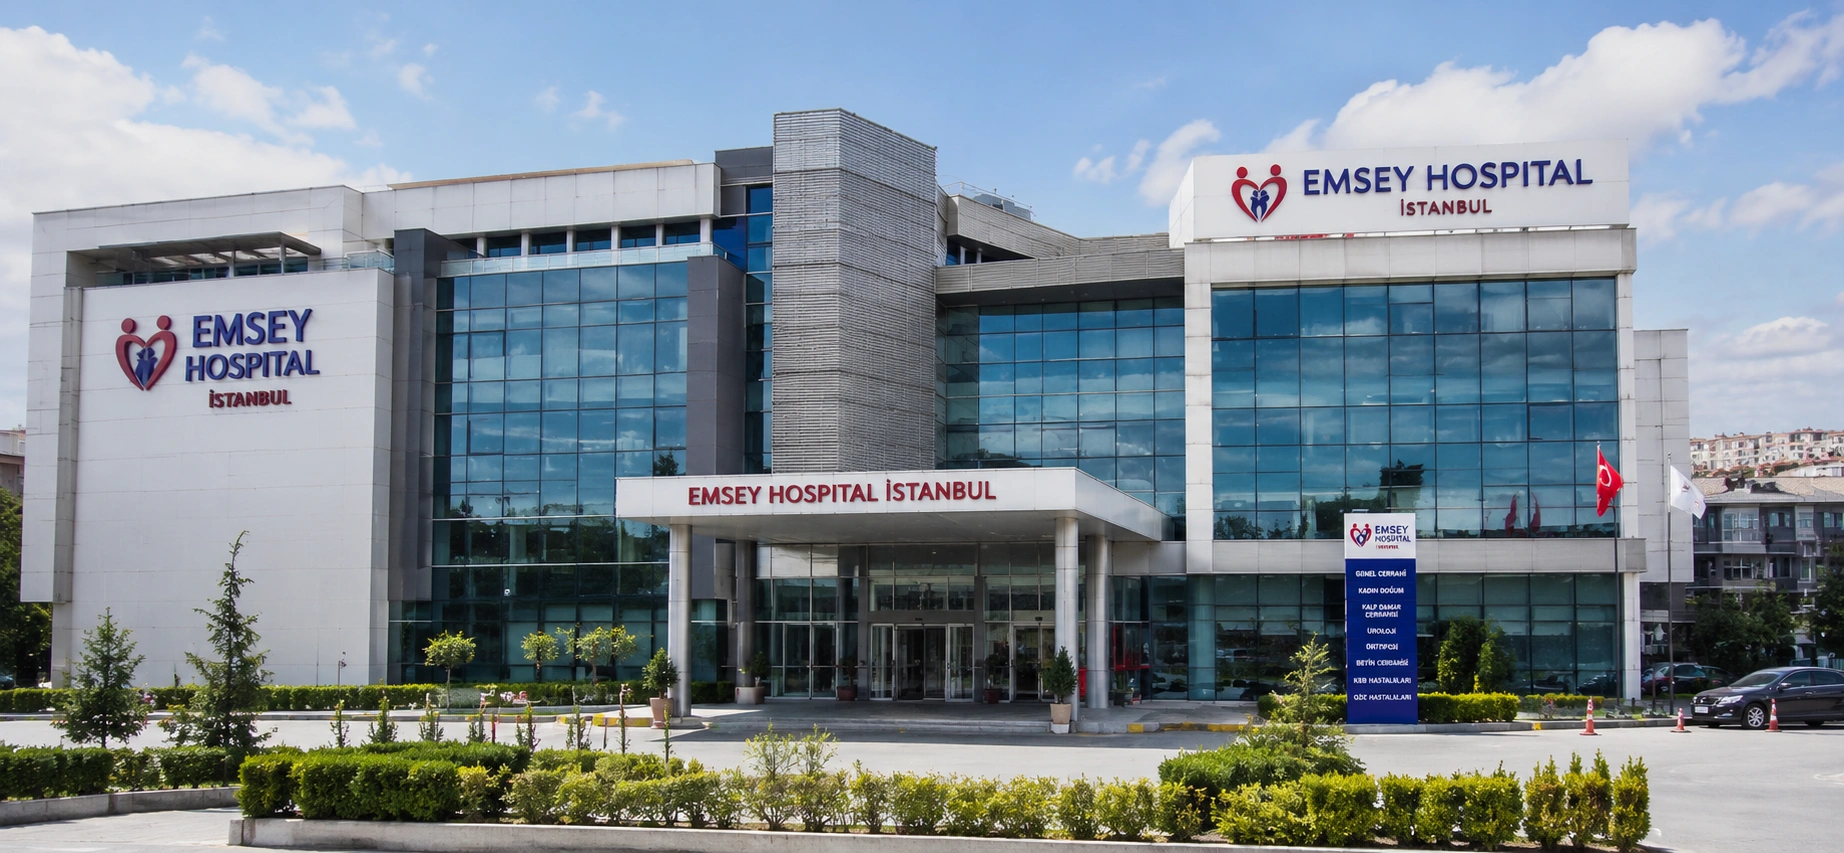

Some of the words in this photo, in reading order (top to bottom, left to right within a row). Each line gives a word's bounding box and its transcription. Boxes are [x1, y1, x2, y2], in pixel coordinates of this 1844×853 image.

[1303, 165, 1415, 195] EMSEY
[1427, 158, 1594, 191] HOSPITAL
[1400, 199, 1493, 216] İSTANBUL
[192, 308, 313, 348] EMSEY
[185, 349, 320, 382] HOSPITAL
[208, 389, 292, 408] İSTANBUL
[688, 485, 762, 506] EMSEY
[769, 483, 879, 504] HOSPITAL
[886, 478, 997, 502] İSTANBUL
[1375, 525, 1409, 535] EMSEY
